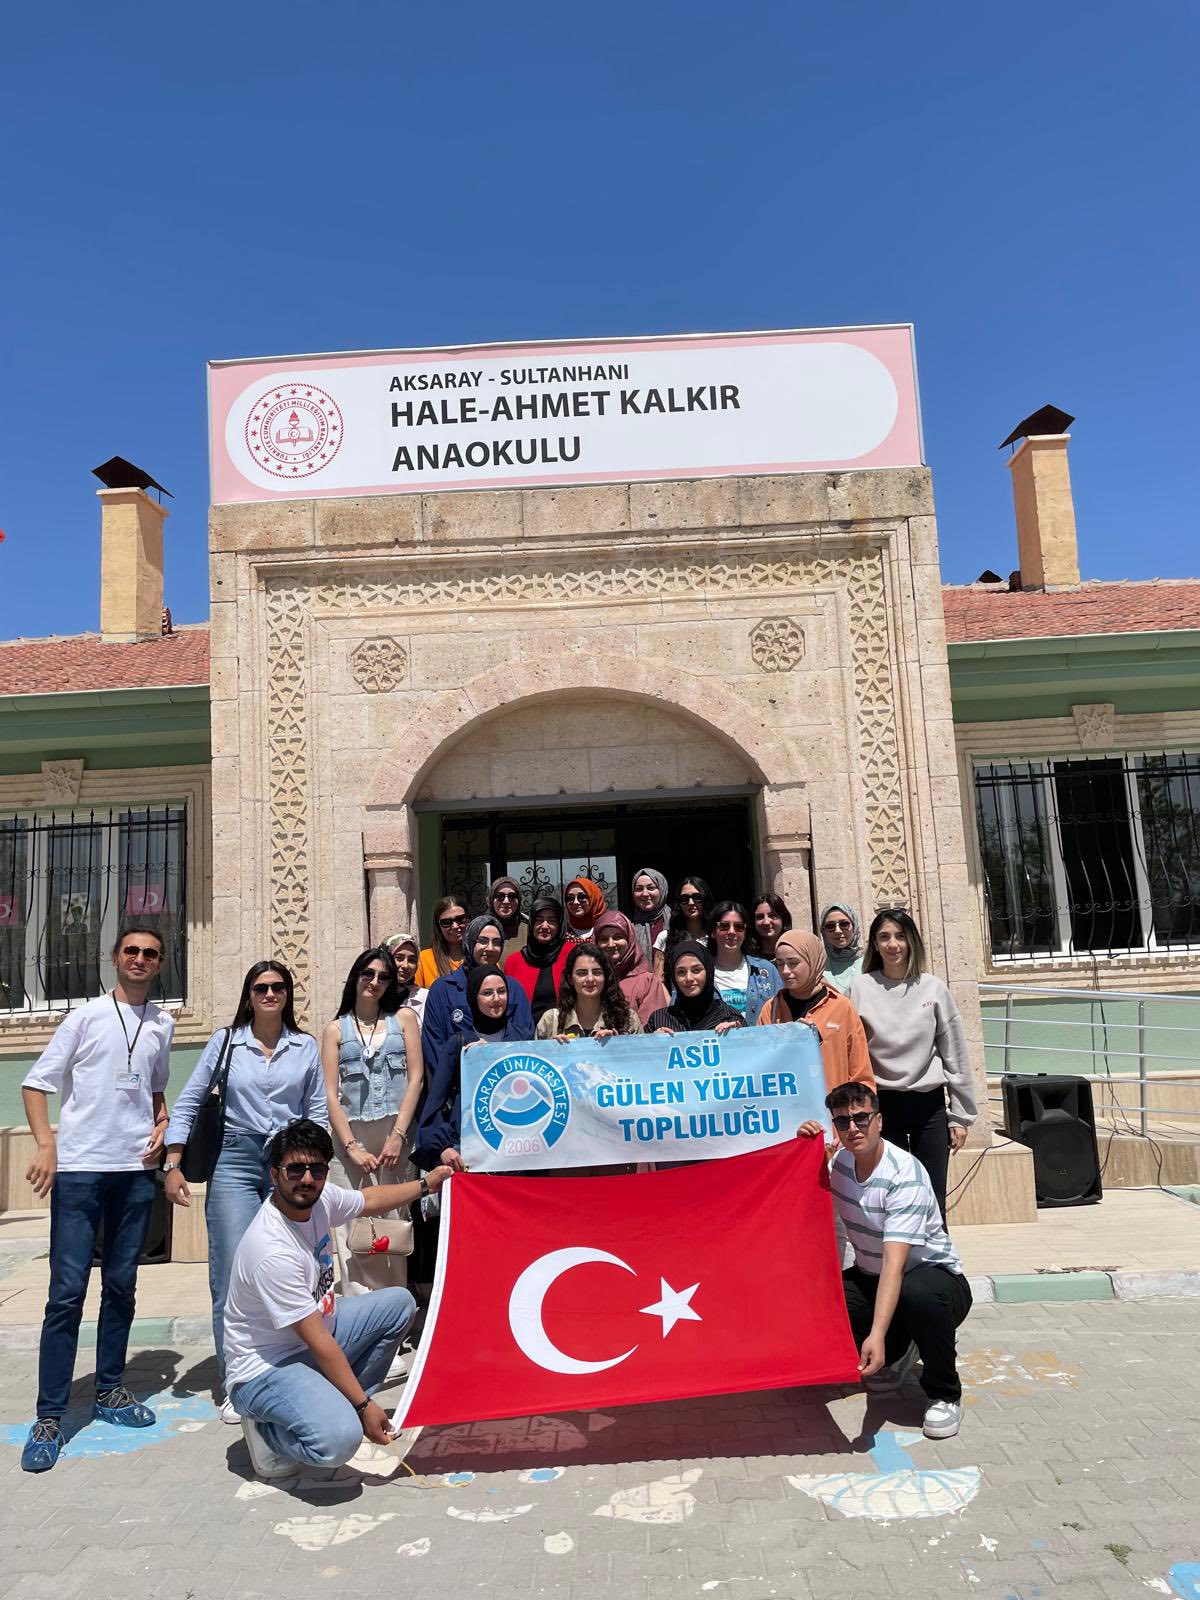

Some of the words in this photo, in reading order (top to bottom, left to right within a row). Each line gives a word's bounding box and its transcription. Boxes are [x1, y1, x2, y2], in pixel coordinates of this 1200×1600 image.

[389, 370, 483, 393] AKSARAY
[500, 364, 629, 386] SULTANHANI
[391, 390, 611, 428] HALE-AHMET
[620, 384, 741, 415] KALKIR
[391, 435, 581, 472] ANAOKULU
[667, 1038, 721, 1070] ASÜ
[477, 1068, 501, 1132] AKSARAY
[503, 1057, 567, 1127] ÜNİVERSİTESİ
[597, 1078, 685, 1108] GÜLEN
[693, 1072, 798, 1102] YÜZLER
[618, 1104, 780, 1142] TOPLULUĞU
[507, 1139, 540, 1153] 2006
